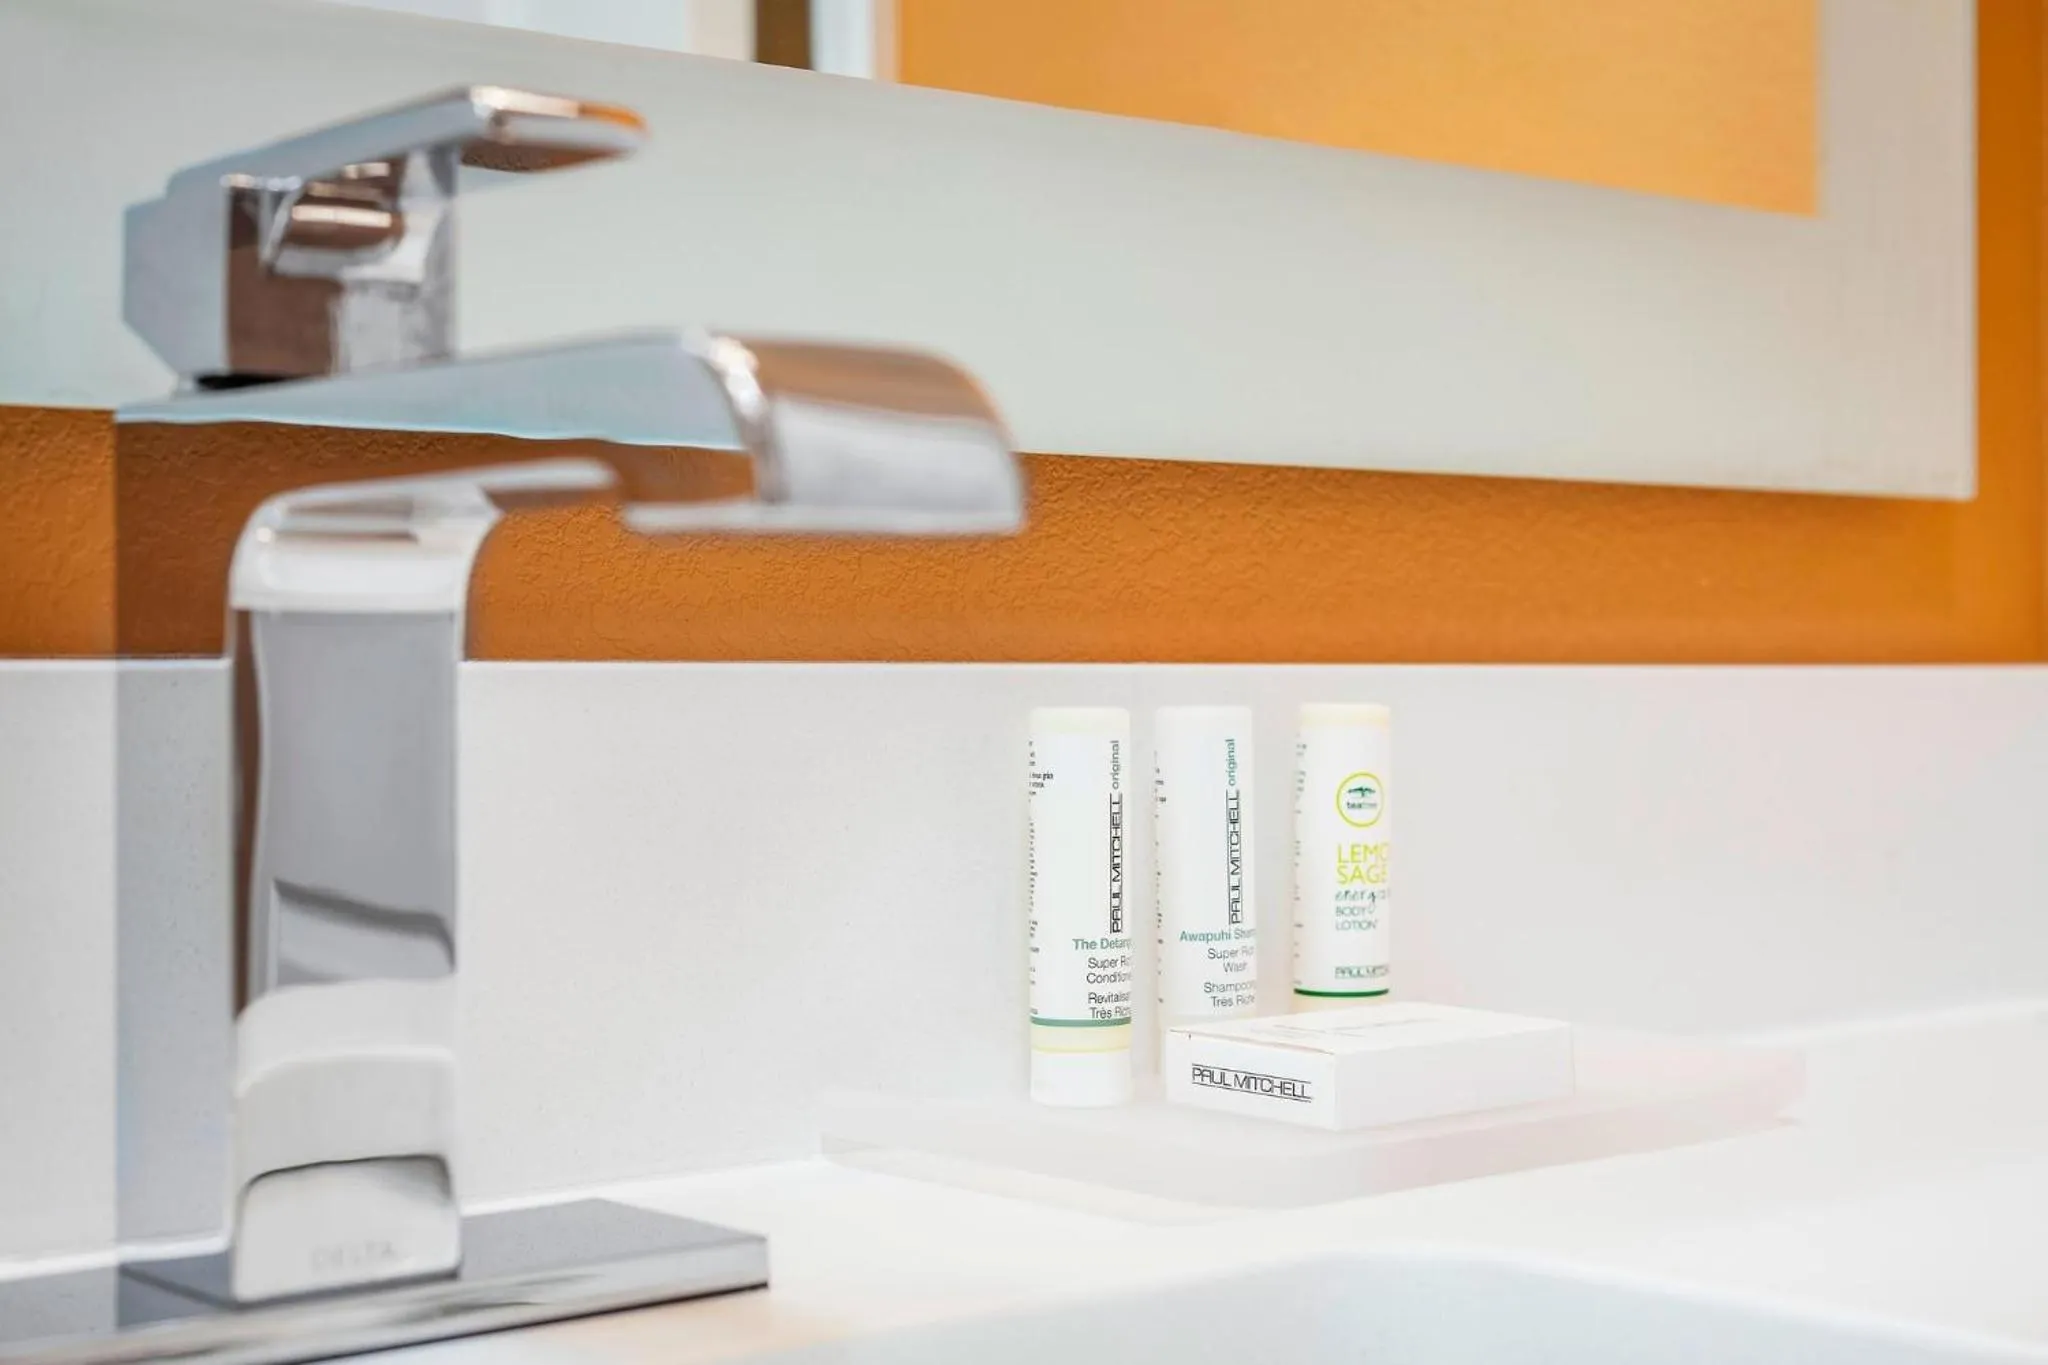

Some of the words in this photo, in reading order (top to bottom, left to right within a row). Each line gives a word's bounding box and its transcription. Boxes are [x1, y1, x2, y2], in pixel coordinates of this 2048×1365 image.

[1110, 740, 1120, 790] original
[1226, 738, 1236, 787] original
[1110, 796, 1122, 882] MITCHELL
[1227, 792, 1240, 875] MITCHELL
[1110, 885, 1122, 933] PAUL
[1228, 878, 1241, 925] PAUL
[1072, 938, 1098, 951] The
[1179, 930, 1231, 944] Awapuhi
[1207, 948, 1238, 961] Super
[1087, 957, 1118, 970] Super
[1192, 1066, 1232, 1088] PAUL
[1233, 1072, 1312, 1099] MITCHELL
